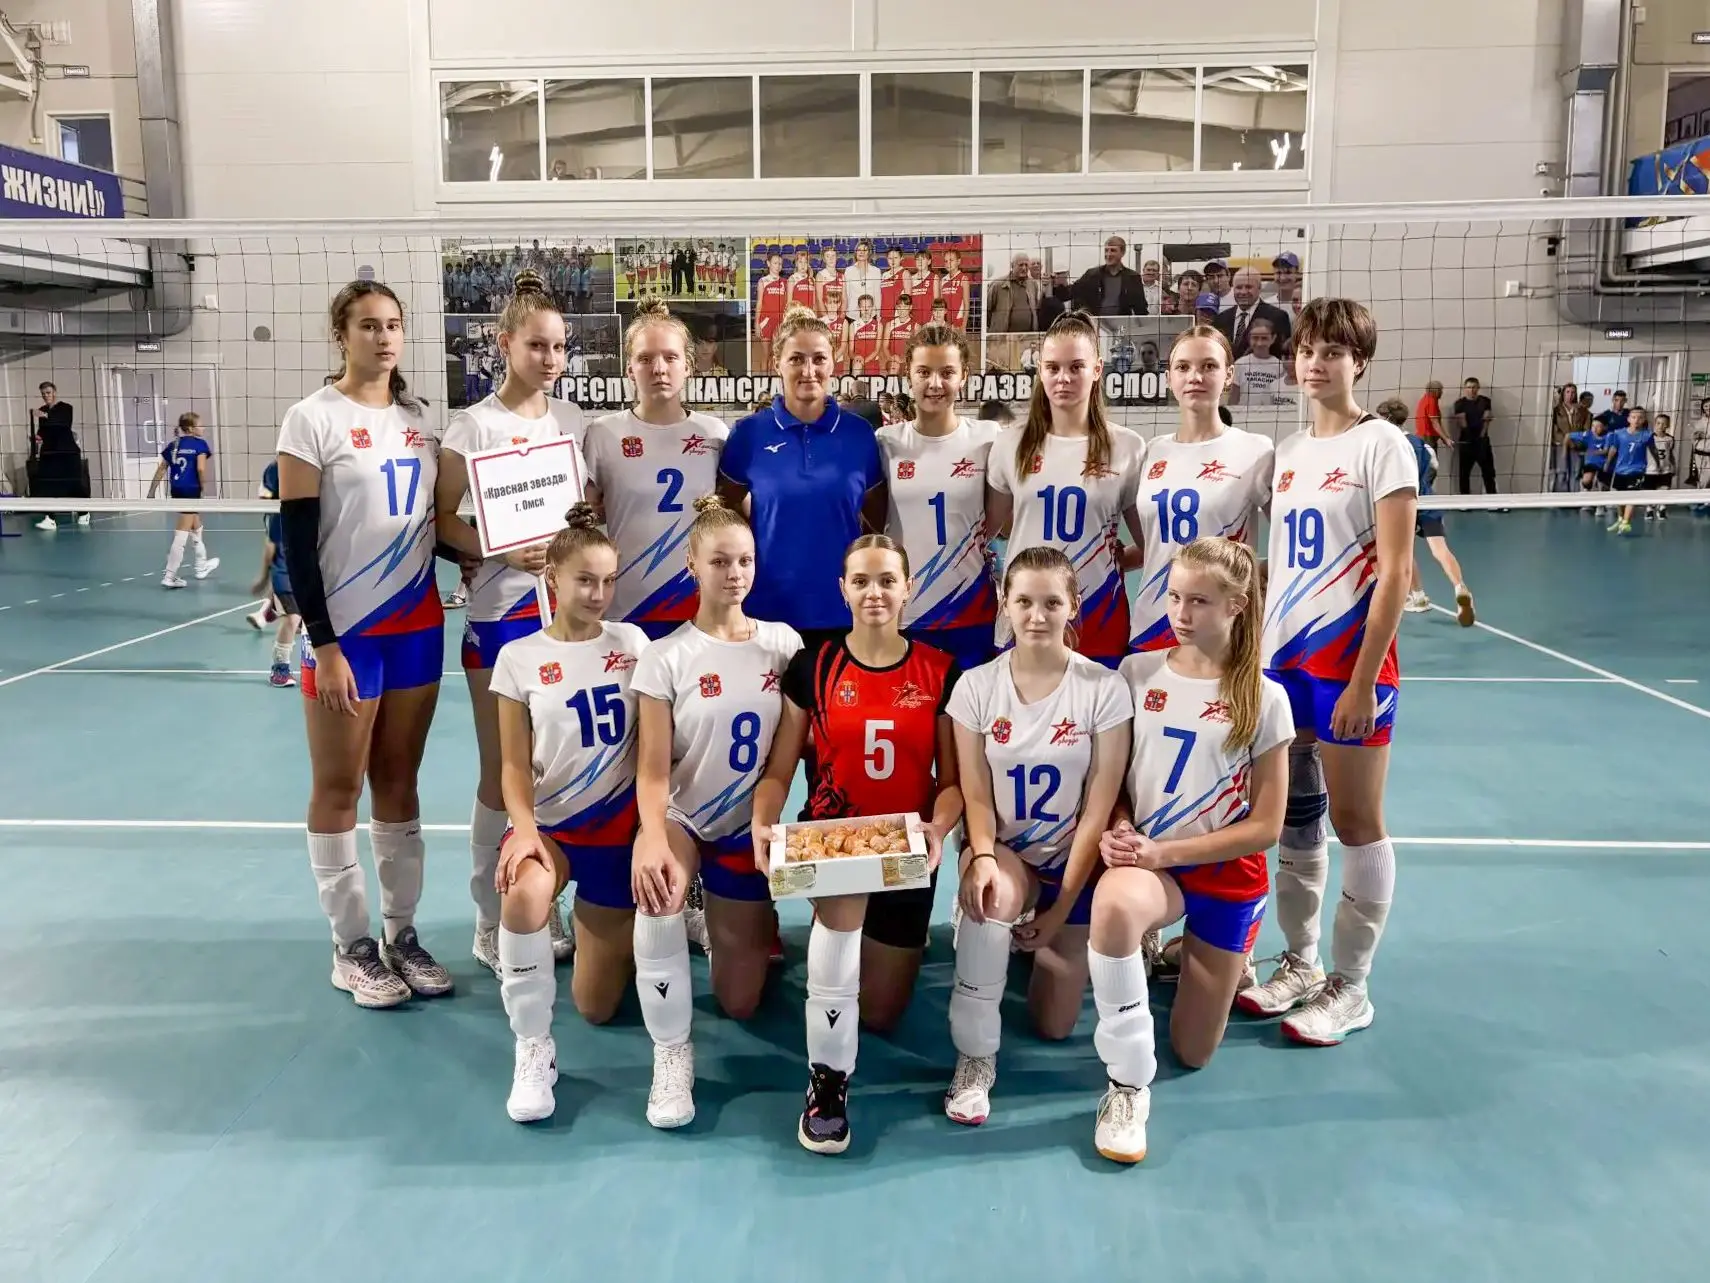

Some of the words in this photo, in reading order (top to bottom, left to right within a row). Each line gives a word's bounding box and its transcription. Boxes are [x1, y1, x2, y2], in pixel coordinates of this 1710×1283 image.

[380, 458, 421, 516] 17
[484, 482, 529, 500] «Красная
[530, 473, 568, 490] звезда»
[515, 502, 522, 512] г.
[522, 497, 545, 511] Омск
[656, 468, 685, 513] 2
[1037, 485, 1087, 543] 10
[928, 491, 947, 545] 1
[1151, 488, 1200, 546] 18
[1284, 507, 1325, 570] 19
[565, 683, 627, 748] 15
[728, 711, 762, 773] 8
[864, 719, 895, 780] 5
[1162, 726, 1197, 795] 7
[1006, 764, 1062, 822] 12
